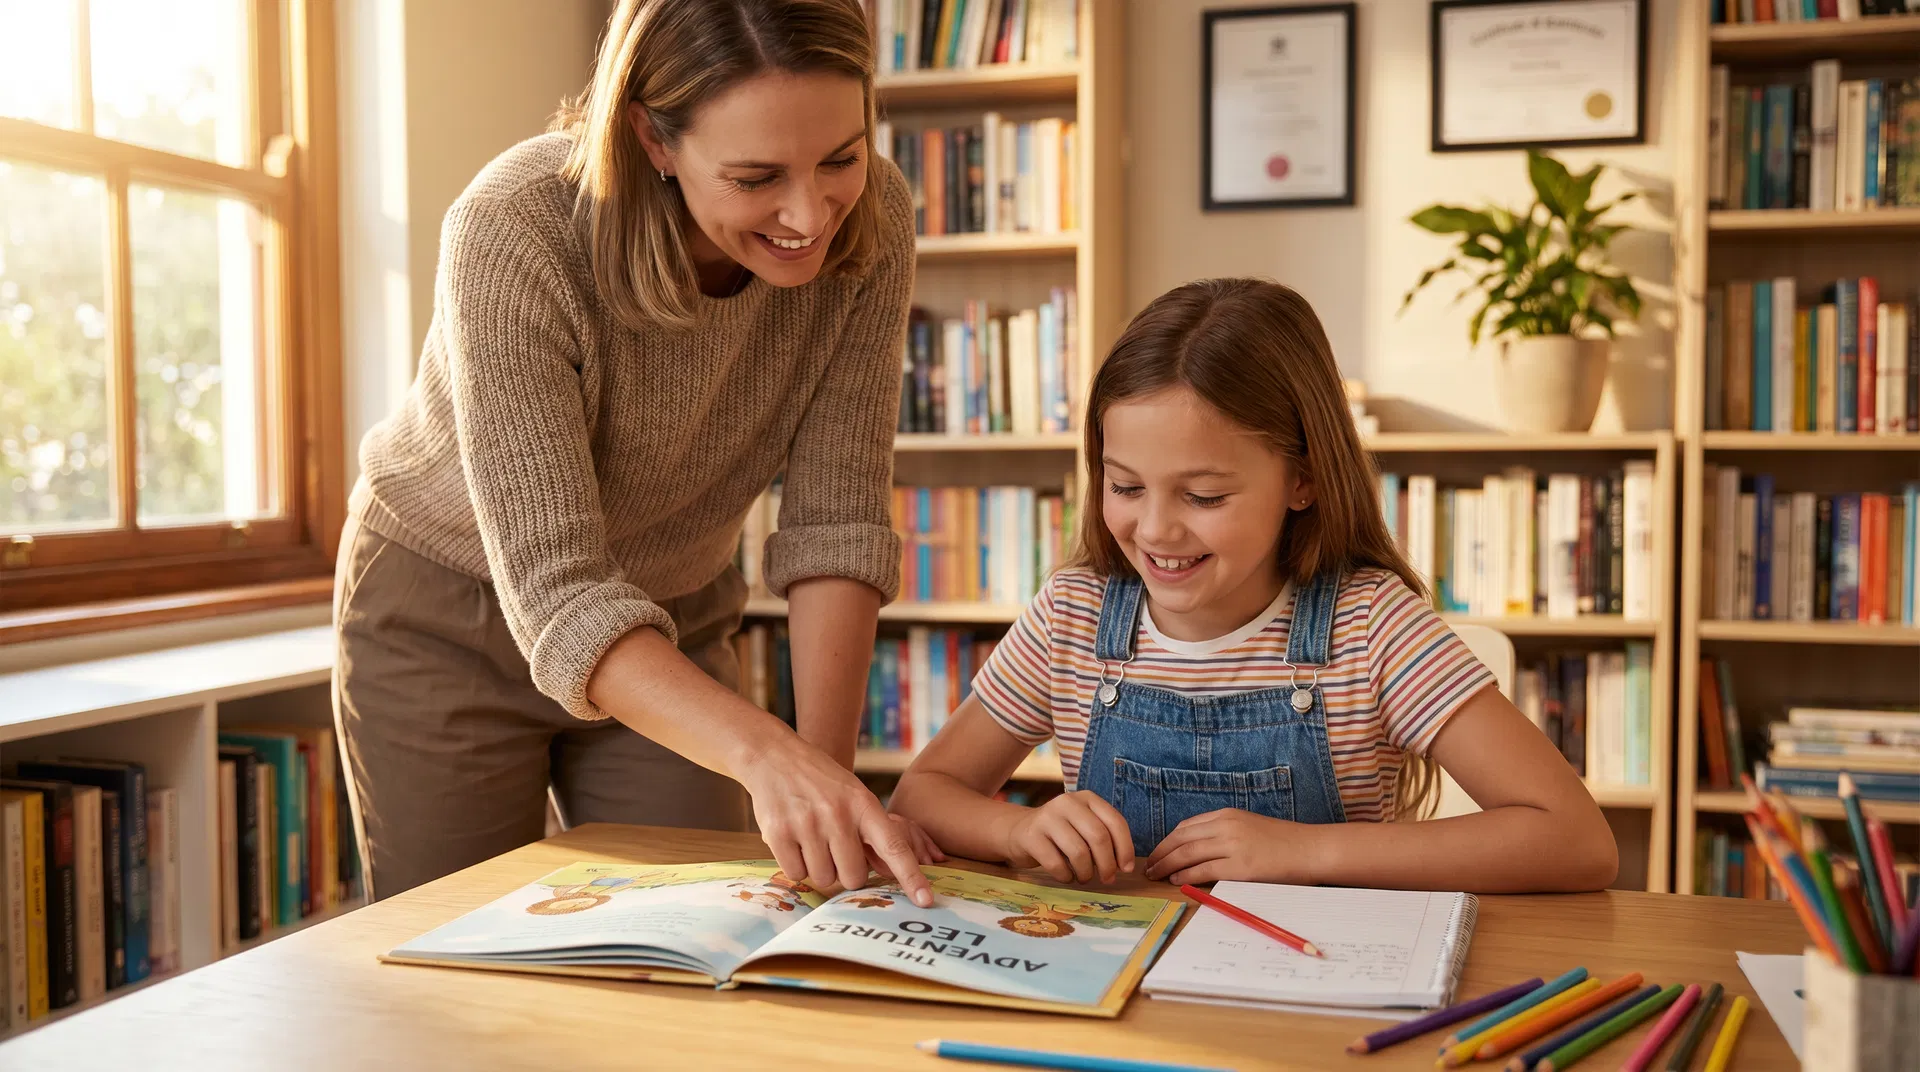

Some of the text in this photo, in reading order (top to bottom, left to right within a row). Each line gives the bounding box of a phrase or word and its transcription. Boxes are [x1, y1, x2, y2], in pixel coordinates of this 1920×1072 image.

[809, 922, 1049, 972] ADVENTURES
[898, 920, 987, 947] LEO
[888, 948, 936, 967] THE
